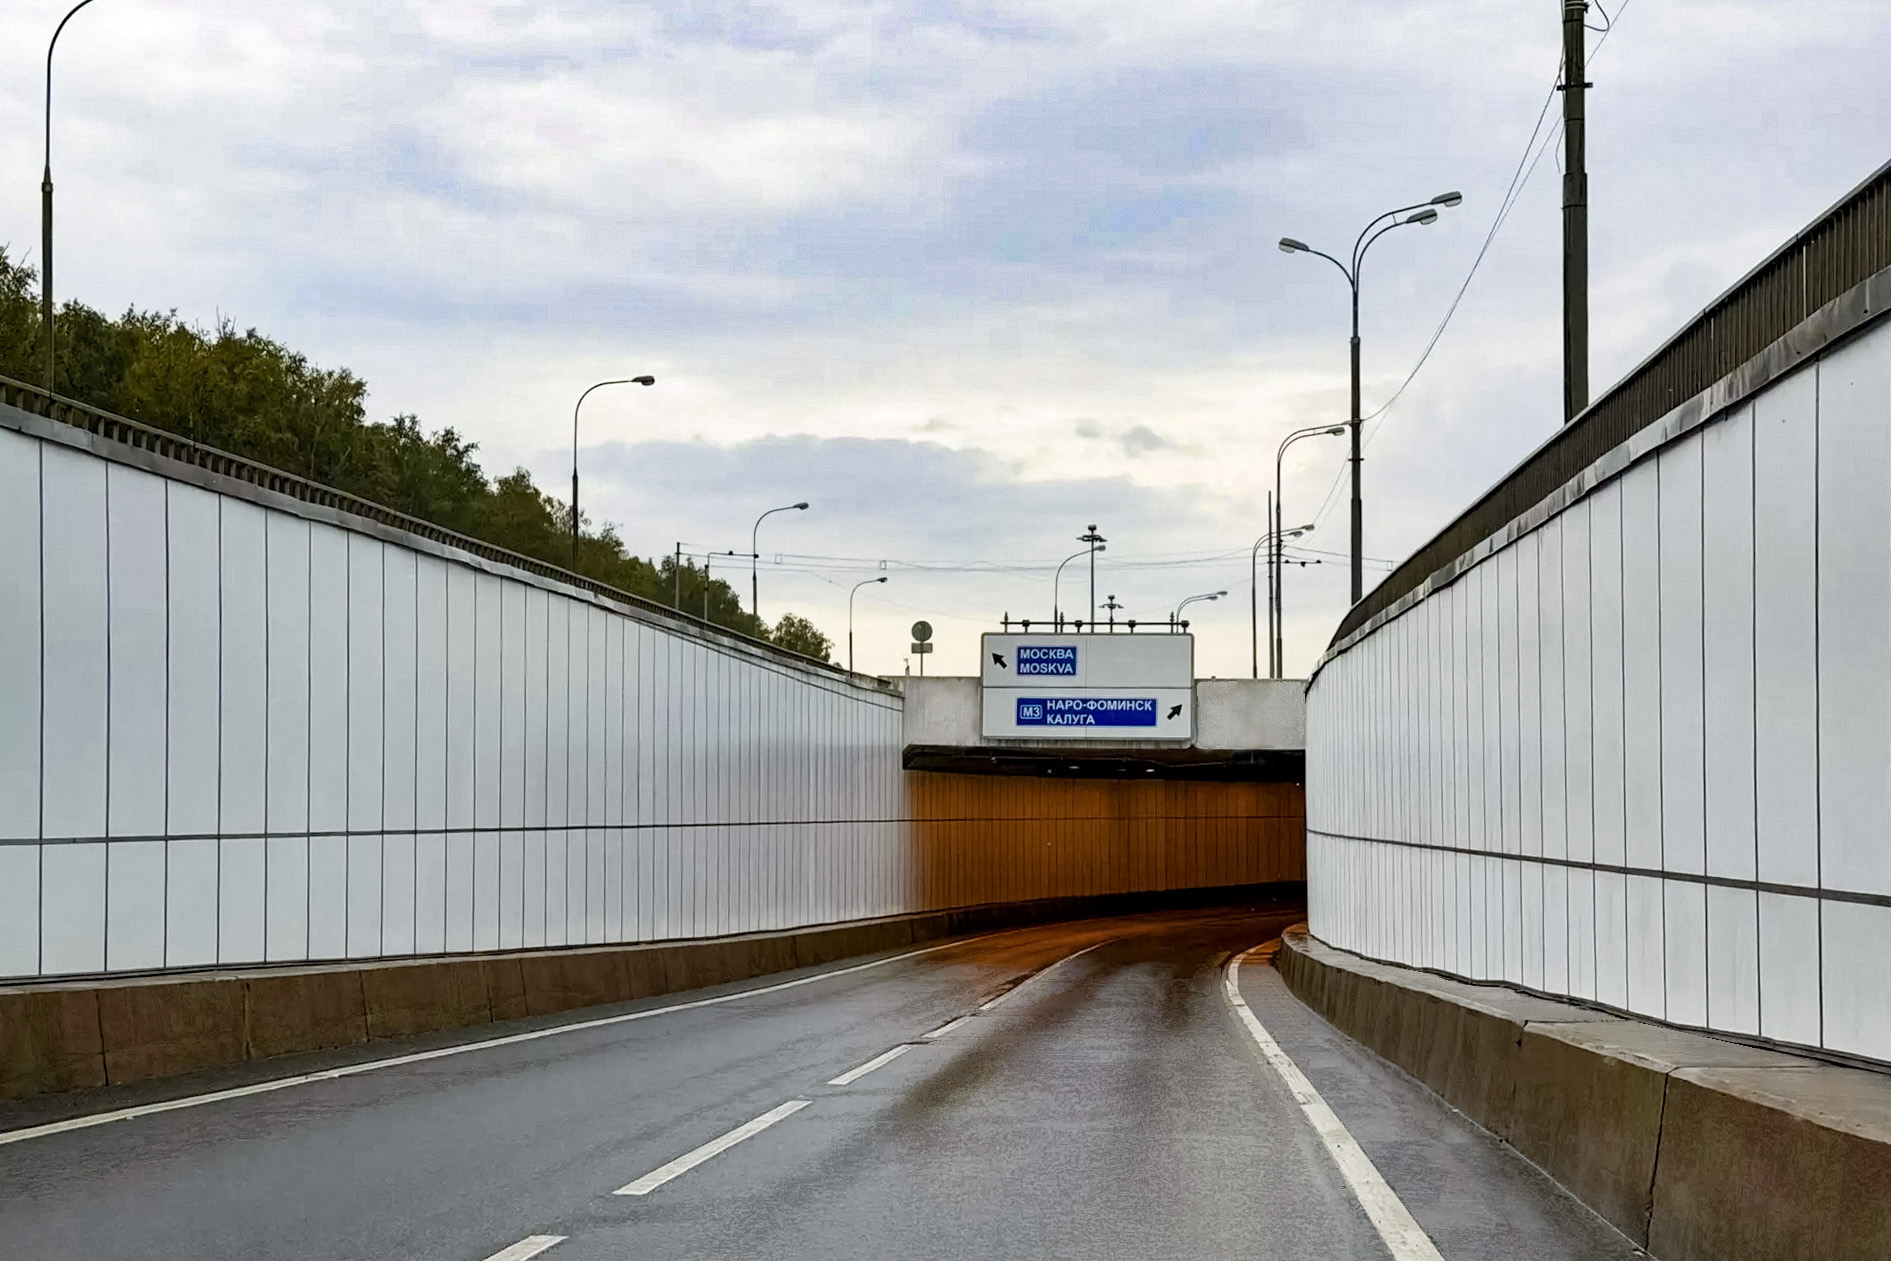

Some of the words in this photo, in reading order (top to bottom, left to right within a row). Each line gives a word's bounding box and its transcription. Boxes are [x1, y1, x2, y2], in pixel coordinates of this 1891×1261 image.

[1020, 649, 1074, 660] МОСКВА
[1020, 663, 1074, 674] MOSKVA
[1047, 700, 1152, 711] НАРО-ФОМИНСК
[1047, 714, 1095, 725] КАЛУГА
